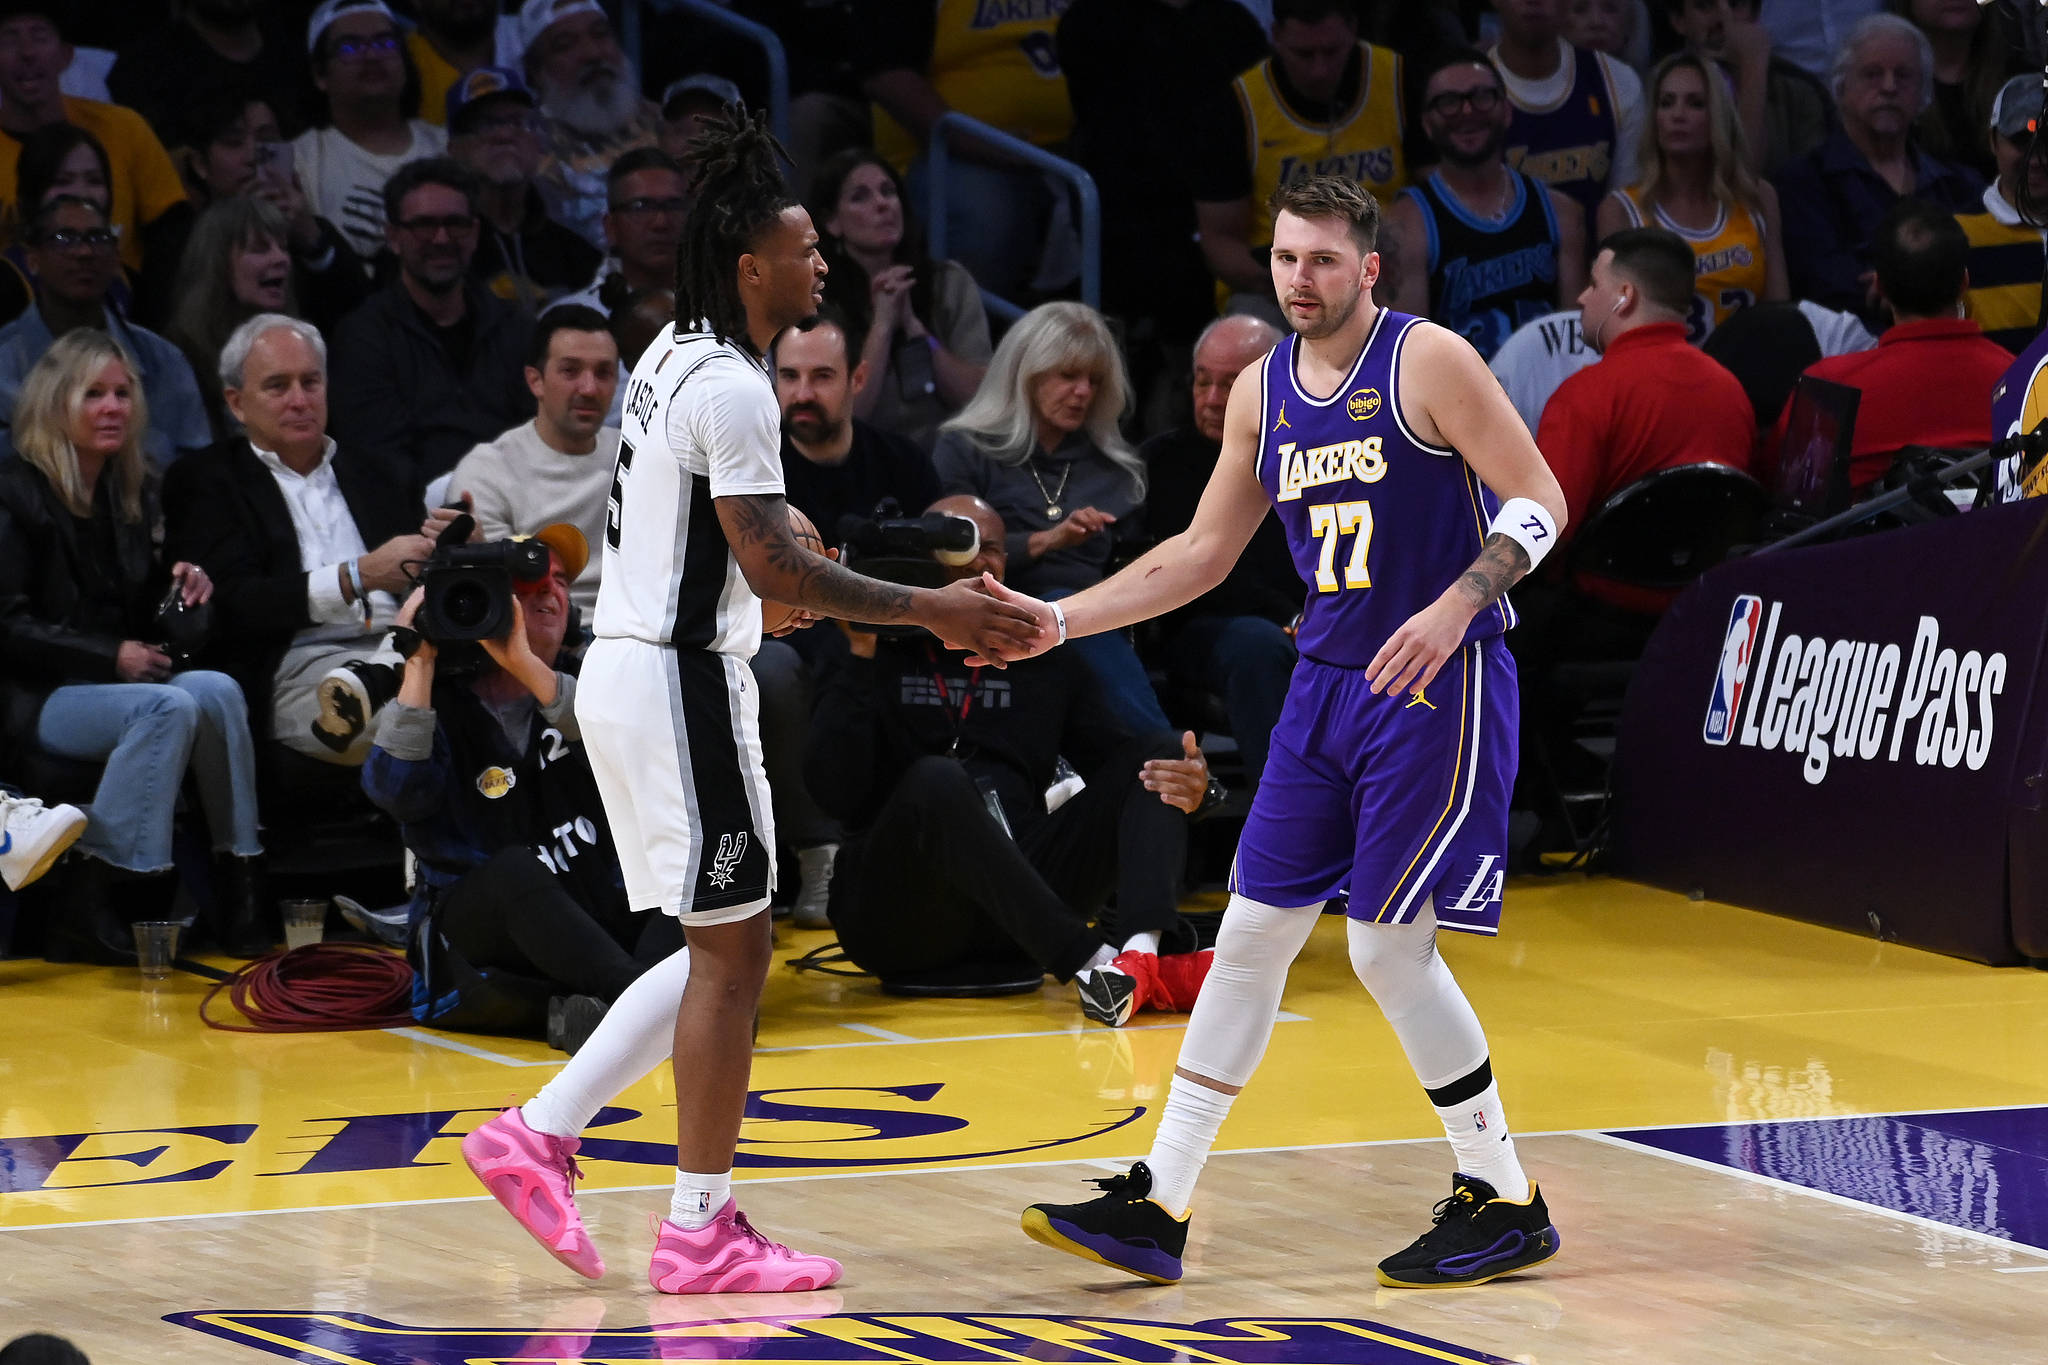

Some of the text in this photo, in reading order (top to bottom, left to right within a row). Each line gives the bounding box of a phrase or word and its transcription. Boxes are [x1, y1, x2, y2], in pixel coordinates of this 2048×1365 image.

[626, 378, 659, 436] CASTLE
[1350, 396, 1379, 410] bibigo
[1277, 436, 1388, 502] LAKERS
[1308, 500, 1374, 592] 77
[1520, 514, 1548, 542] 77
[901, 676, 1011, 708] ESPN
[1740, 601, 2007, 785] League Pass
[1708, 710, 1725, 734] NBA
[1445, 854, 1504, 912] LA
